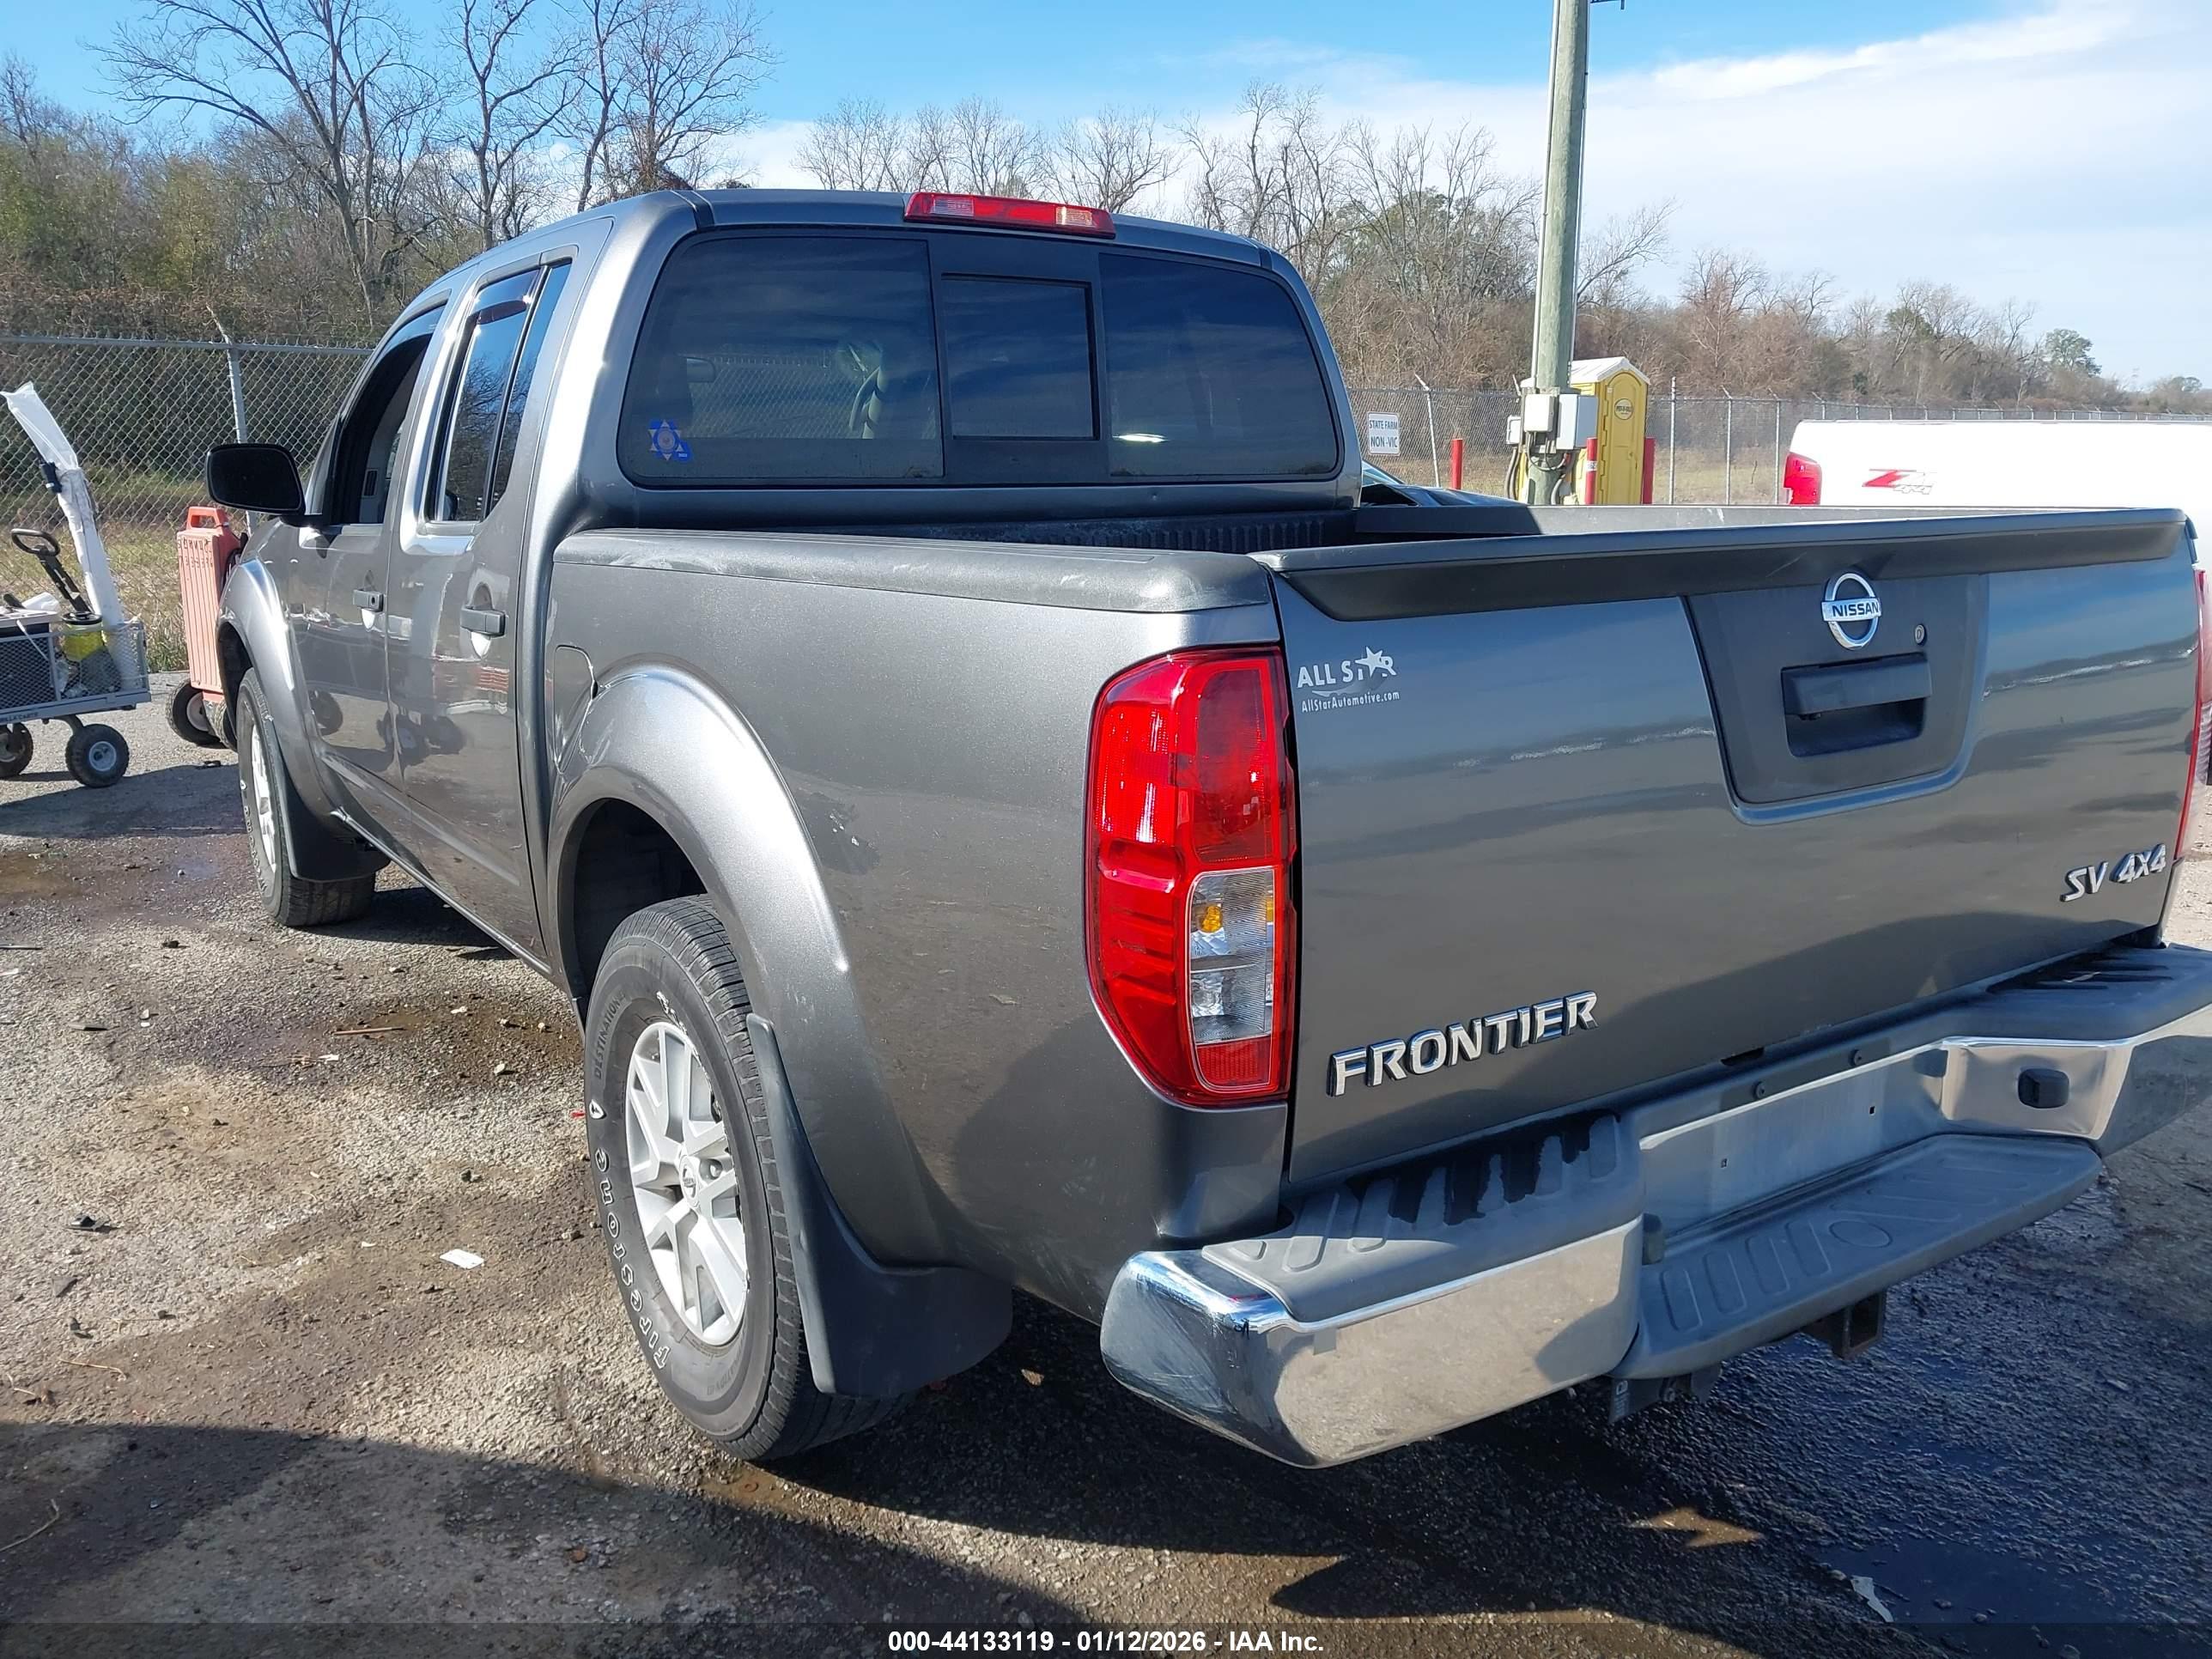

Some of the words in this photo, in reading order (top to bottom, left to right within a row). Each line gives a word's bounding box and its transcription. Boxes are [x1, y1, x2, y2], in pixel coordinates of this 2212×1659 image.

[1369, 420, 1384, 428] STATE
[1384, 421, 1398, 429] FARM
[1832, 601, 1879, 617] NISSAN
[1297, 664, 1336, 688] ALL
[1301, 691, 1400, 713] AllStarAutomotive.com
[2060, 861, 2109, 902] SV
[1328, 990, 1599, 1097] FRONTIER
